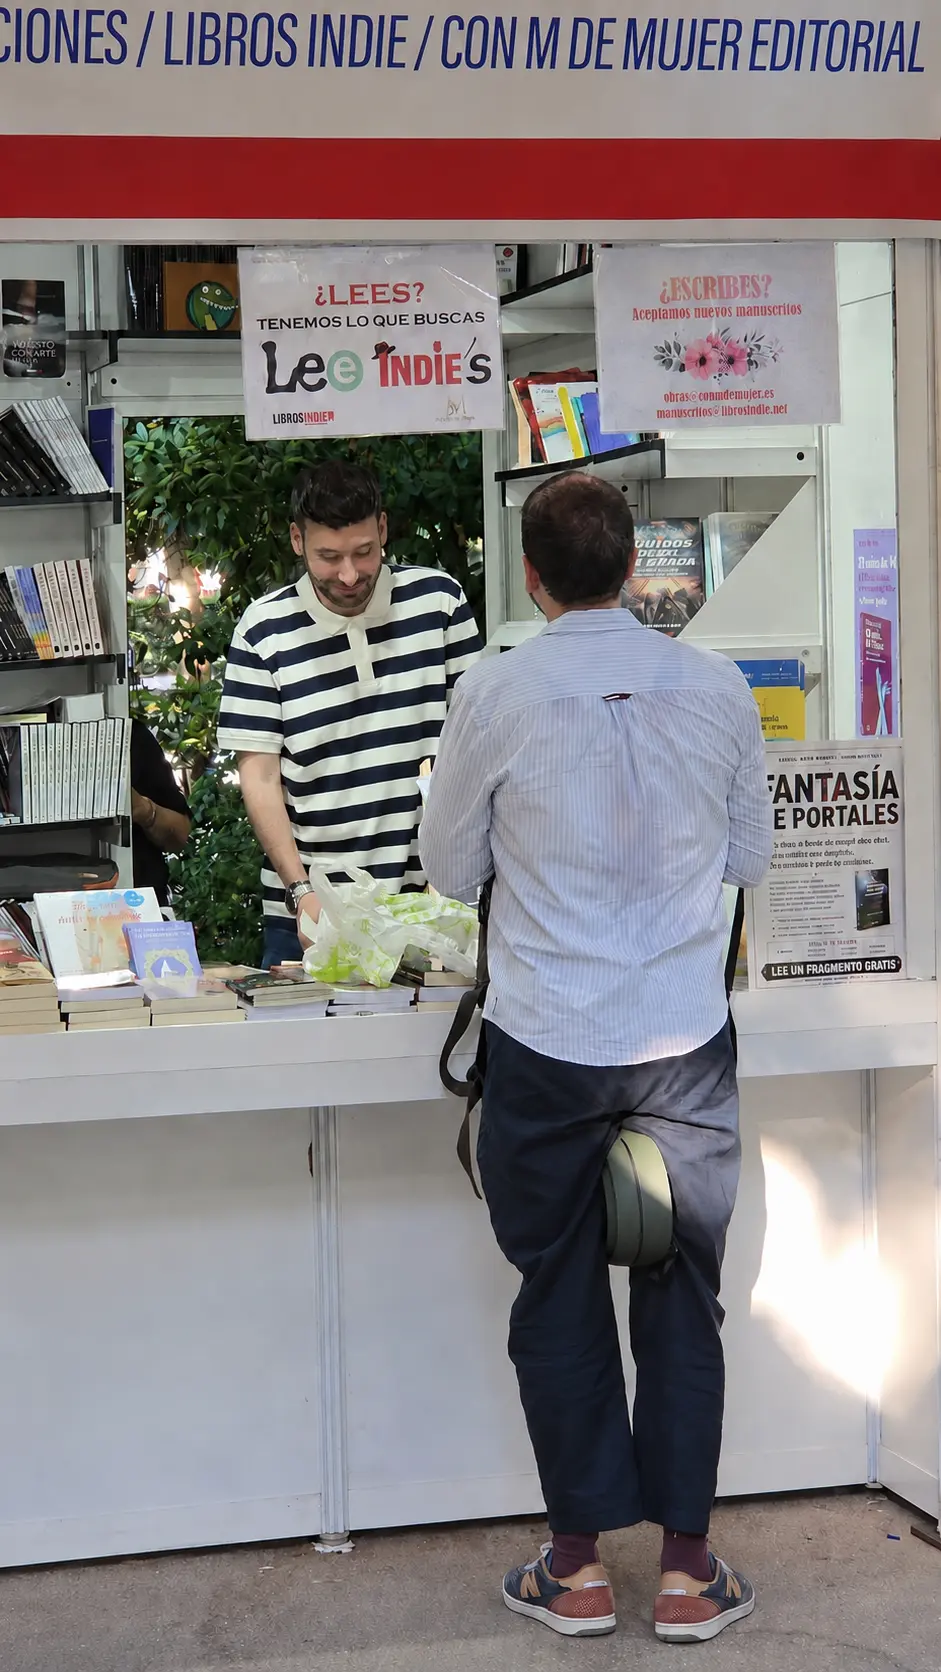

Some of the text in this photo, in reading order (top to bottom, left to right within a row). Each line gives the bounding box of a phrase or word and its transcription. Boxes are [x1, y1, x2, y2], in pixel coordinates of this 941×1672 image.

[164, 11, 298, 67] LIBROS
[307, 14, 408, 69] INDIE
[441, 15, 517, 70] CON
[525, 16, 561, 70] M
[568, 17, 617, 70] DE
[622, 18, 743, 72] MUJER
[748, 19, 926, 73] EDITORIAL
[314, 282, 425, 307] ¿LEES?
[659, 273, 773, 304] ¿ESCRIBES?
[256, 311, 486, 331] TENEMOS LO QUE BUSCAS
[632, 302, 802, 322] Aceptamos nuevos manuscritos
[663, 388, 775, 403] obras@conmdemujer.es
[656, 403, 788, 419] manuscritos@librosindie.net
[792, 803, 899, 829] PORTALES
[771, 959, 897, 976] LEE UN FRAGMENTO GRATIS
